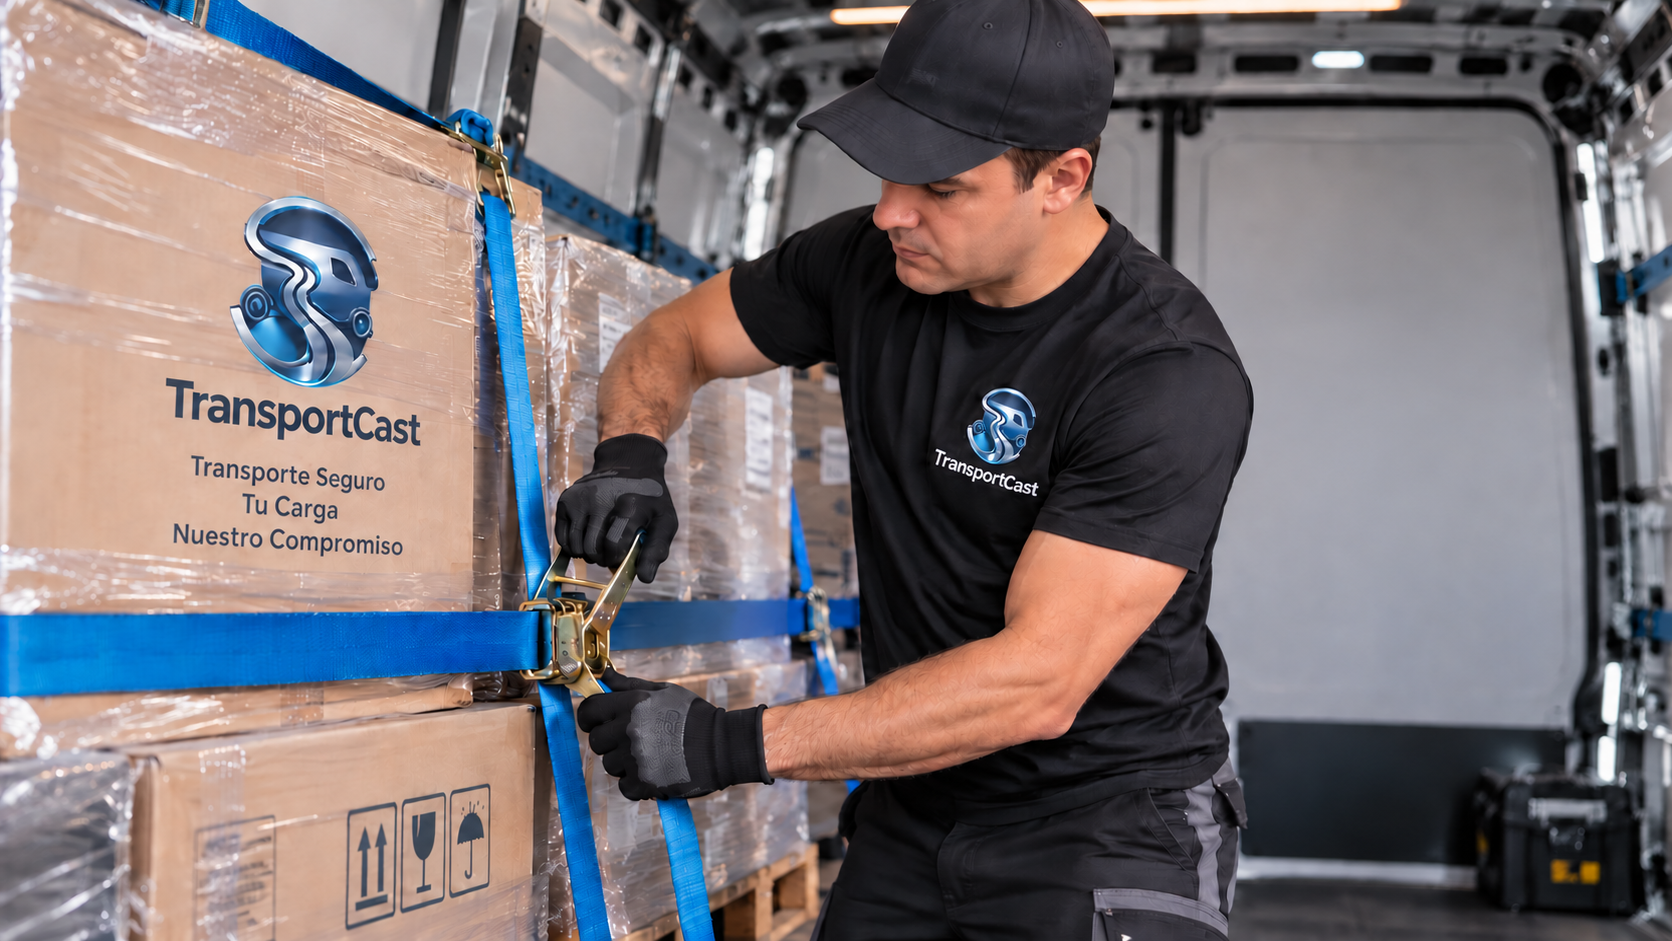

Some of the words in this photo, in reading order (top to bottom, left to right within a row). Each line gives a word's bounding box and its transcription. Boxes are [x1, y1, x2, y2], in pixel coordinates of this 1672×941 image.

[166, 378, 420, 446] TransportCast
[191, 455, 310, 486] Transporte
[316, 467, 385, 493] Seguro
[935, 449, 1039, 496] TransportCast
[242, 493, 267, 515] Tu
[275, 495, 338, 523] Carga
[173, 523, 263, 548] Nuestro
[269, 528, 403, 556] Compromiso
